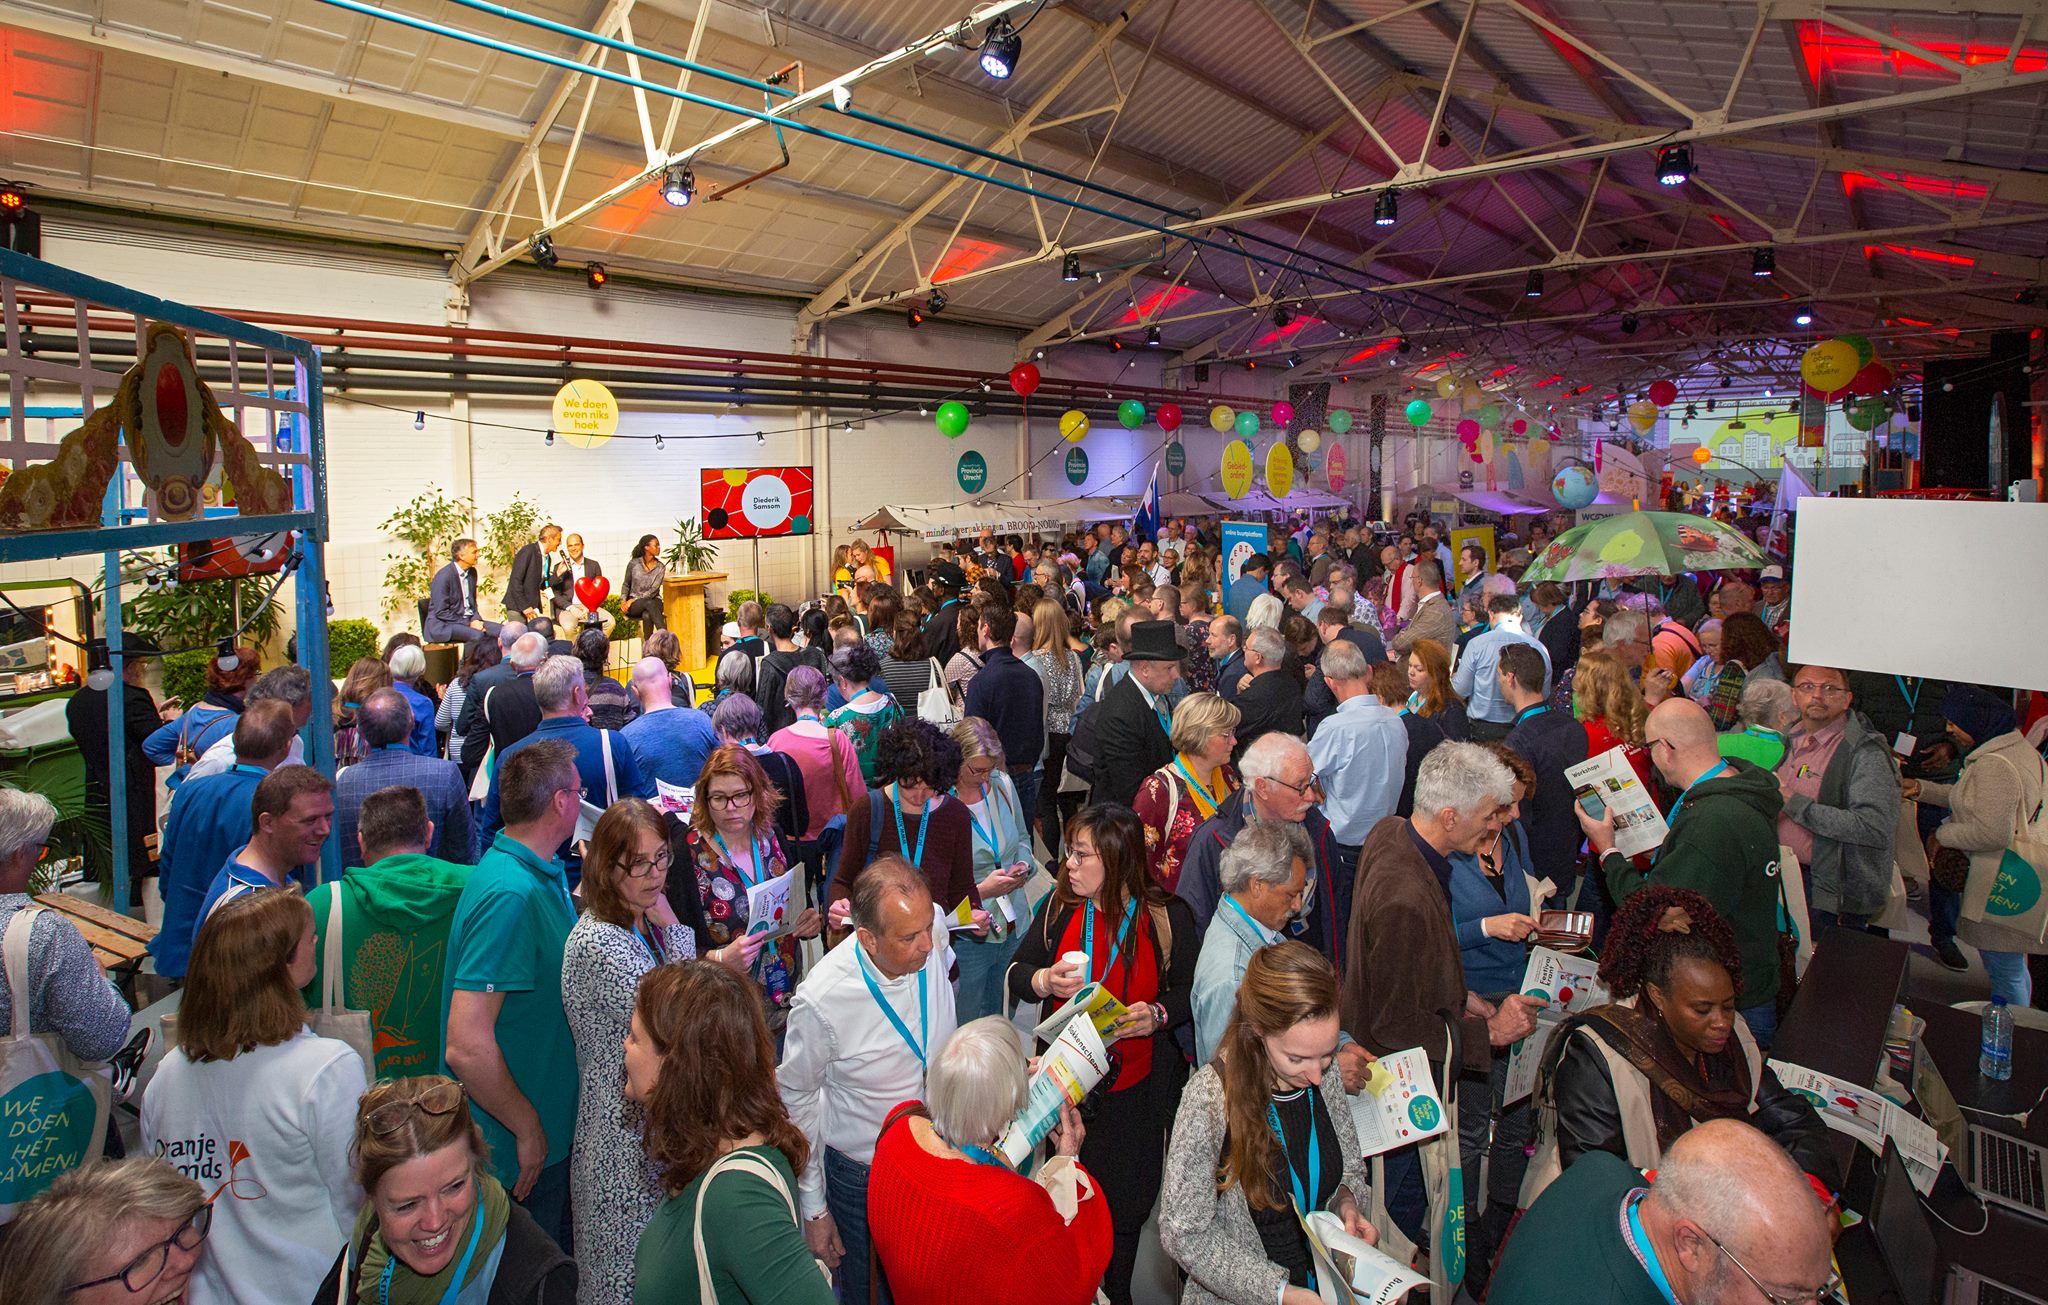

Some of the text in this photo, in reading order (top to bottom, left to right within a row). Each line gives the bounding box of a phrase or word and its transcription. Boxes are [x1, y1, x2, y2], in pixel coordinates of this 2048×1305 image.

[564, 398, 608, 409] We doen
[563, 410, 609, 420] even niks
[574, 419, 599, 430] hoek
[753, 496, 780, 504] Diederik
[1572, 763, 1600, 778] Workshops
[1539, 956, 1551, 986] Festival
[1545, 965, 1554, 987] krant
[5, 1096, 44, 1117] WE
[8, 1112, 70, 1138] DOEN
[11, 1137, 59, 1160] HET
[154, 1133, 216, 1161] Oranje
[169, 1157, 222, 1180] onds
